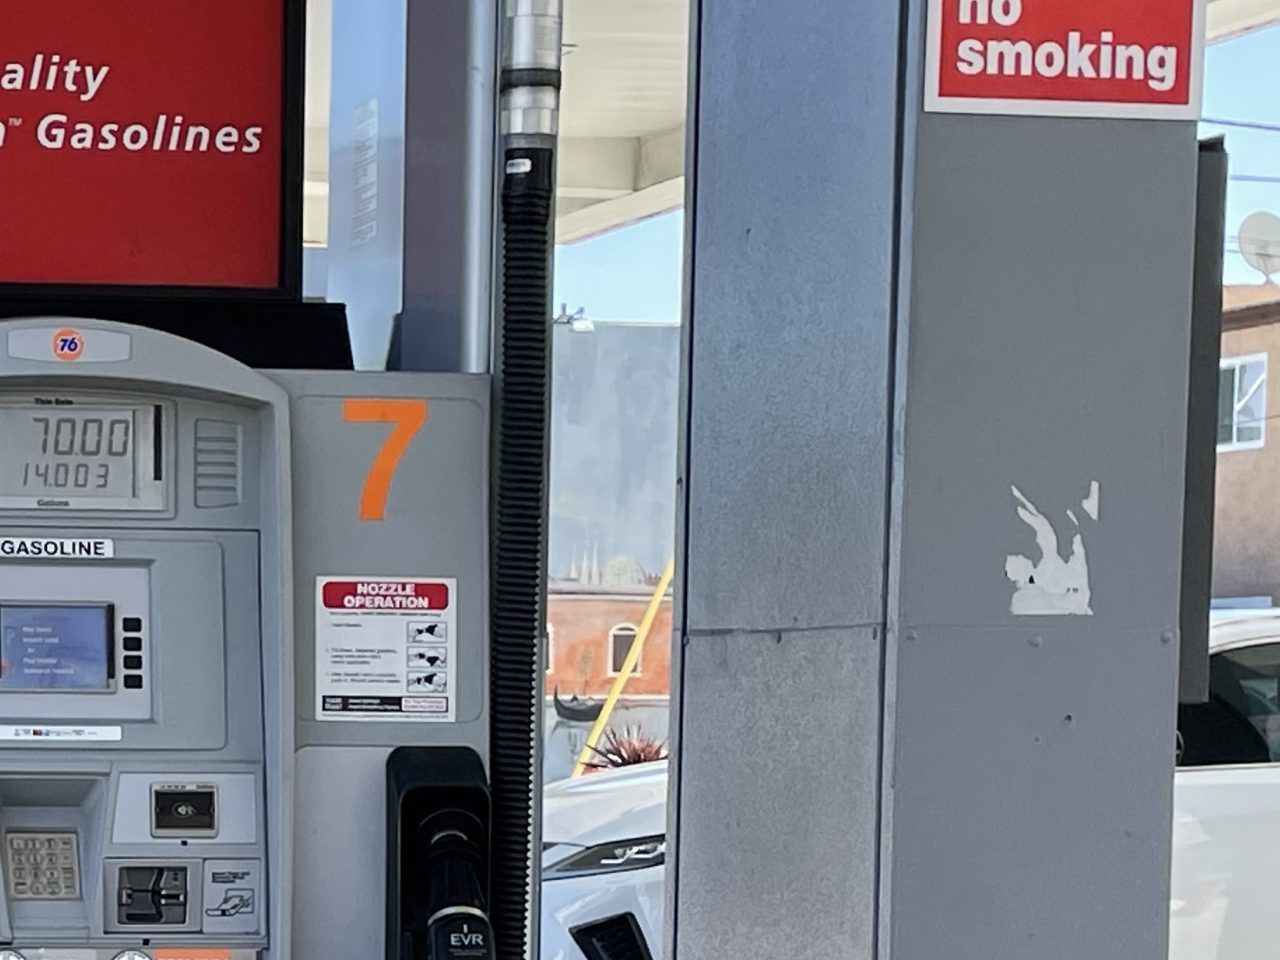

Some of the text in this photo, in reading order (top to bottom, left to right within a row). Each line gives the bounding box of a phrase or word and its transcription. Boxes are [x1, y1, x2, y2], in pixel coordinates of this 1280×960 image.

[958, 0, 1021, 25] no
[956, 32, 1178, 91] smoking
[36, 113, 263, 154] Gasolines
[59, 336, 79, 353] 76
[342, 399, 428, 520] 7
[23, 463, 109, 488] 14.003
[1, 540, 105, 556] GASOLINE
[357, 583, 415, 596] NOZZLE
[343, 595, 429, 608] OPERATION
[450, 933, 484, 946] EVR
